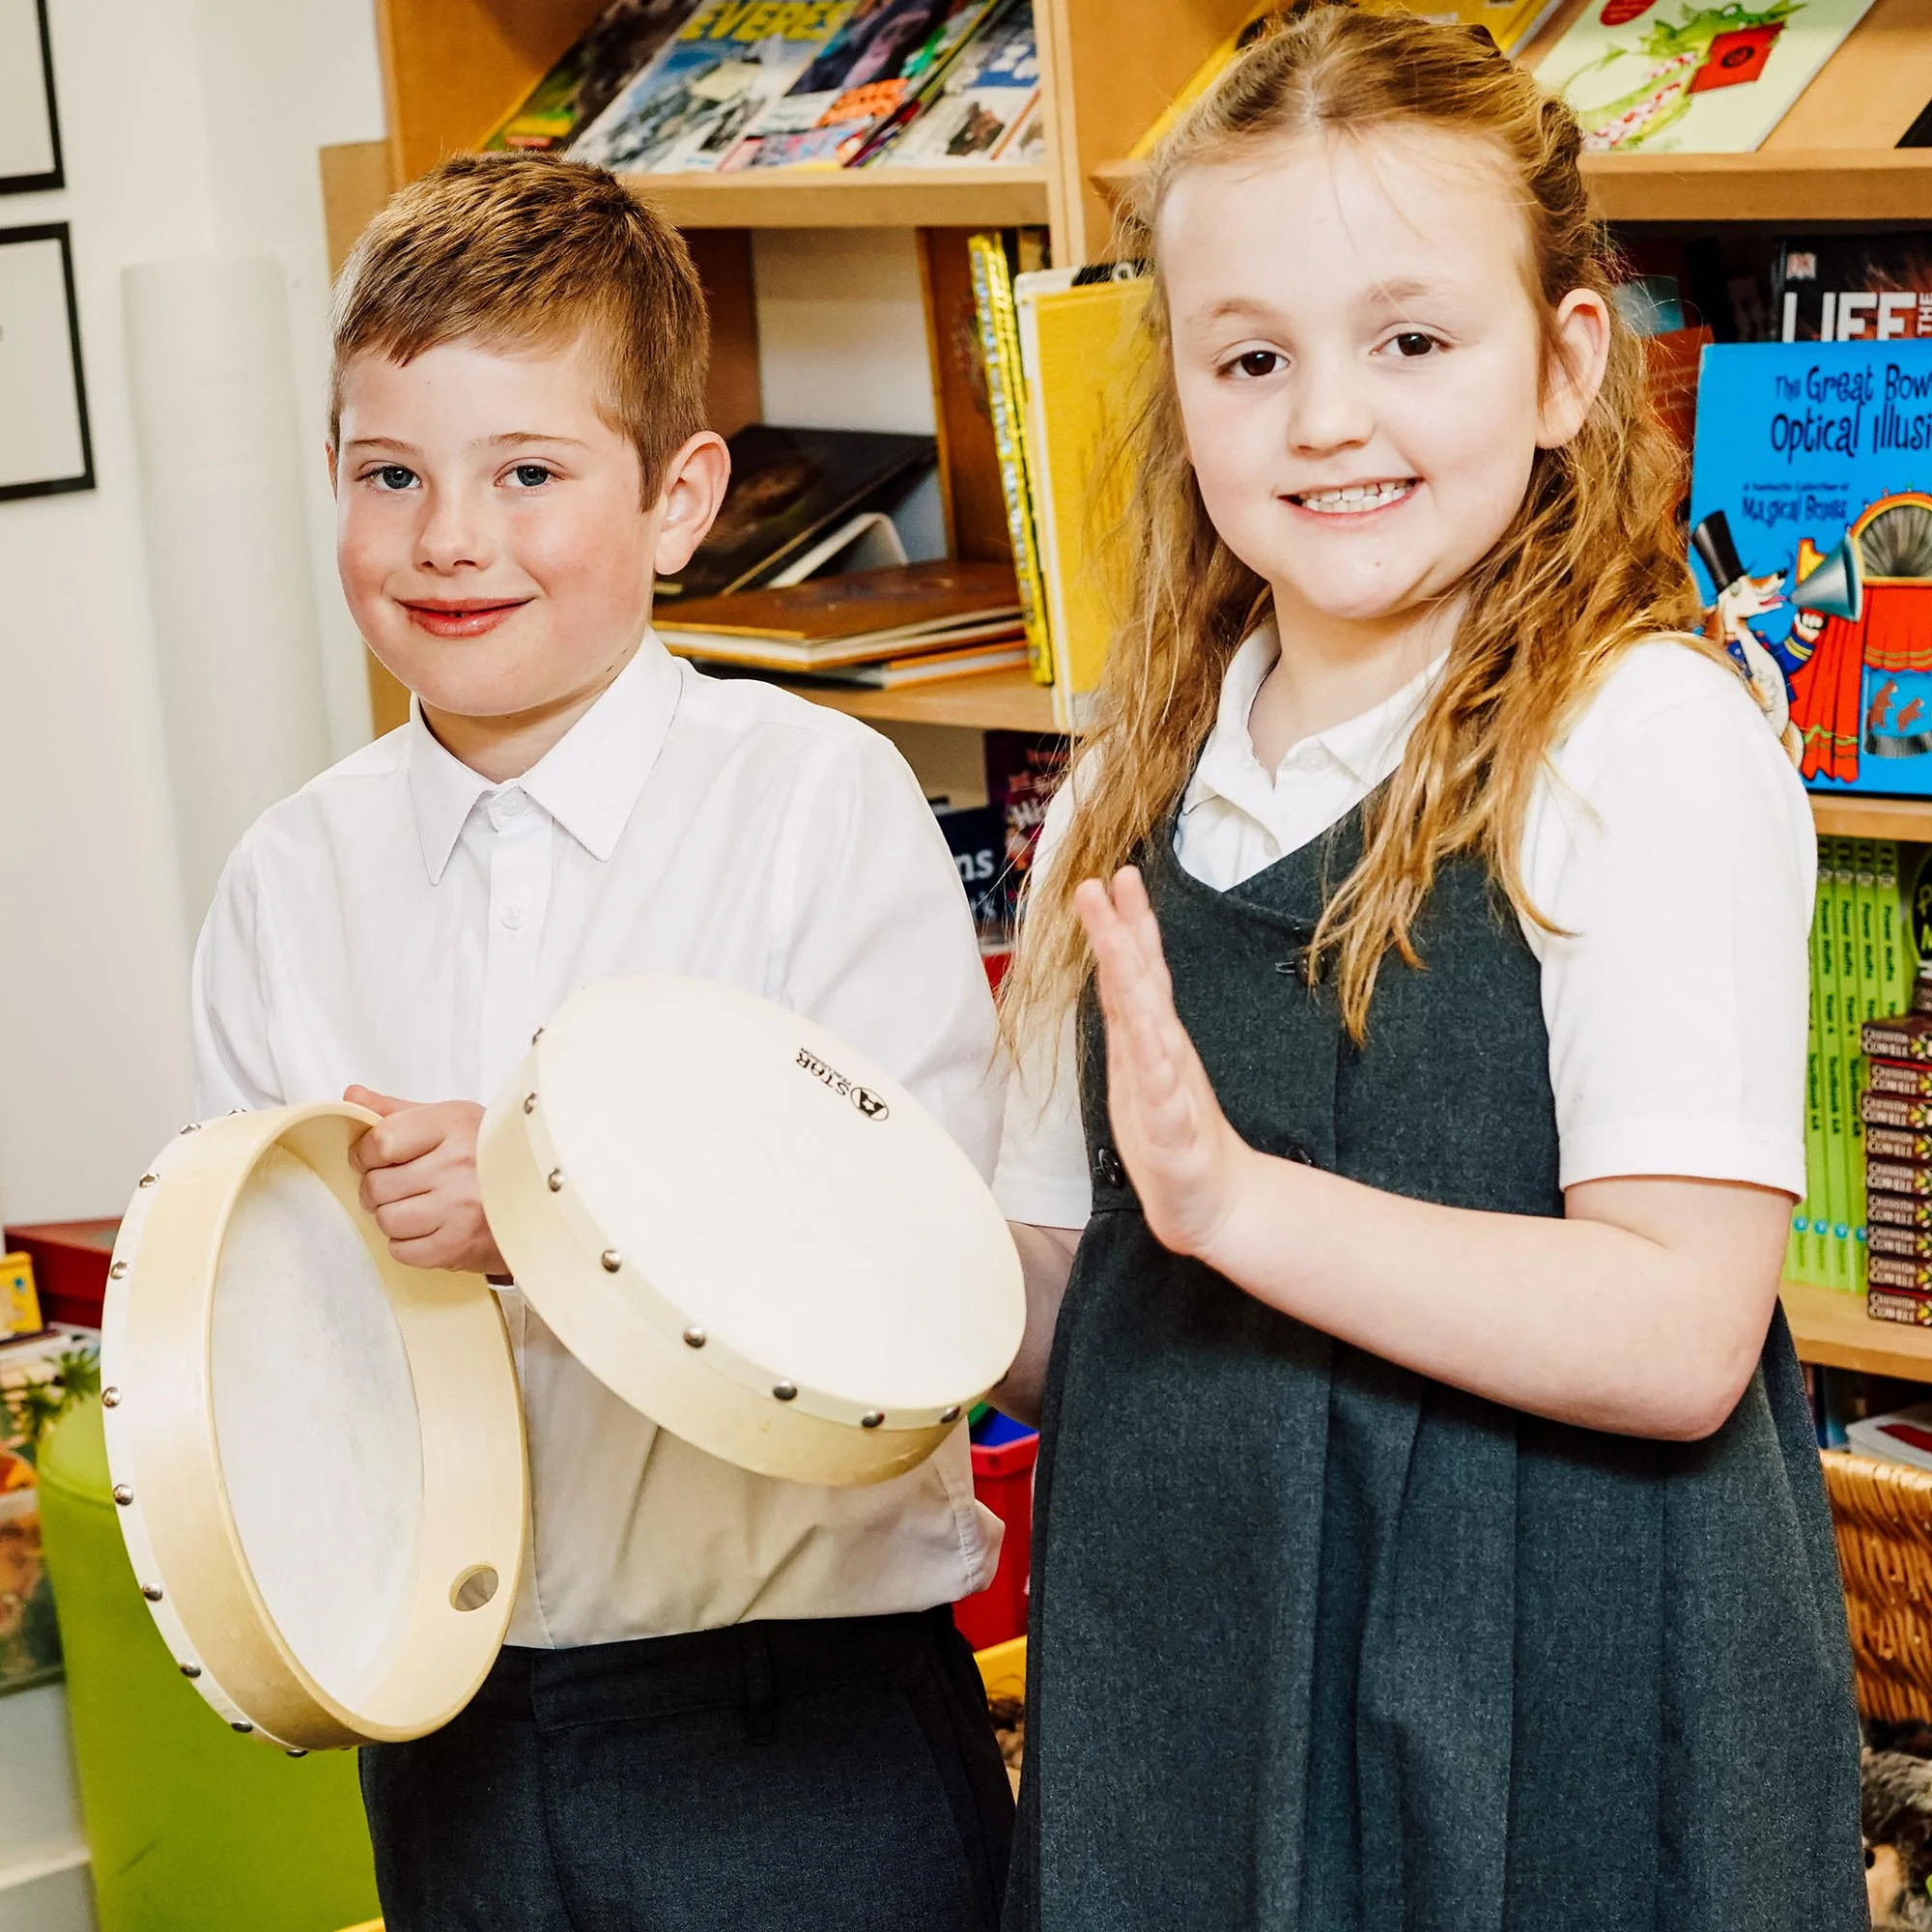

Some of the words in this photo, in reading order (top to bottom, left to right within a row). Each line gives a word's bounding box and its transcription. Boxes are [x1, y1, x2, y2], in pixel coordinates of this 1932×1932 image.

[1776, 375, 1802, 401] The
[1806, 363, 1874, 406] Great
[1772, 403, 1861, 464] Optical
[796, 1052, 849, 1095] STAR
